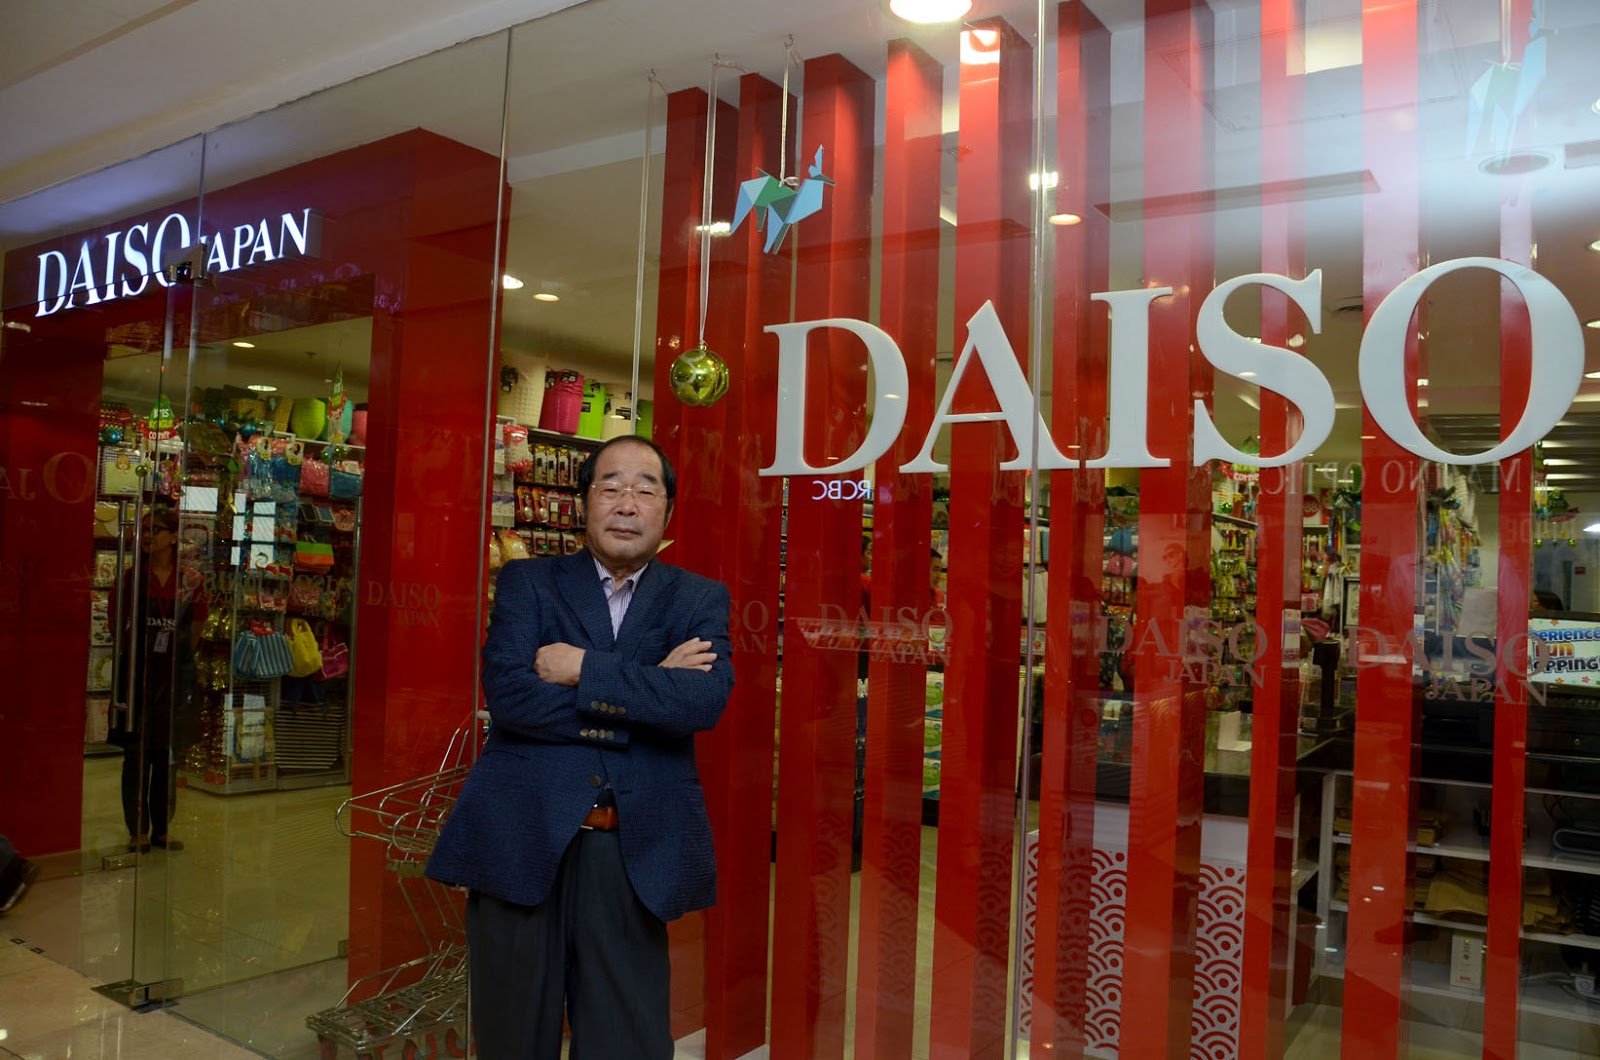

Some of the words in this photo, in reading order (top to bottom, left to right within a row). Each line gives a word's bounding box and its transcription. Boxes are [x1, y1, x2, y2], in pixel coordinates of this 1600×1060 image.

[35, 212, 191, 317] DAISO
[200, 208, 311, 273] APAN
[758, 255, 1586, 478] DAISO
[366, 579, 442, 609] DAISO
[818, 602, 954, 643] DAISO
[1094, 614, 1269, 663] DAISO
[870, 640, 951, 667] JAPAN
[1346, 625, 1549, 677] DAISO
[1163, 658, 1268, 689] JAPAN
[1425, 676, 1548, 707] JAPAN
